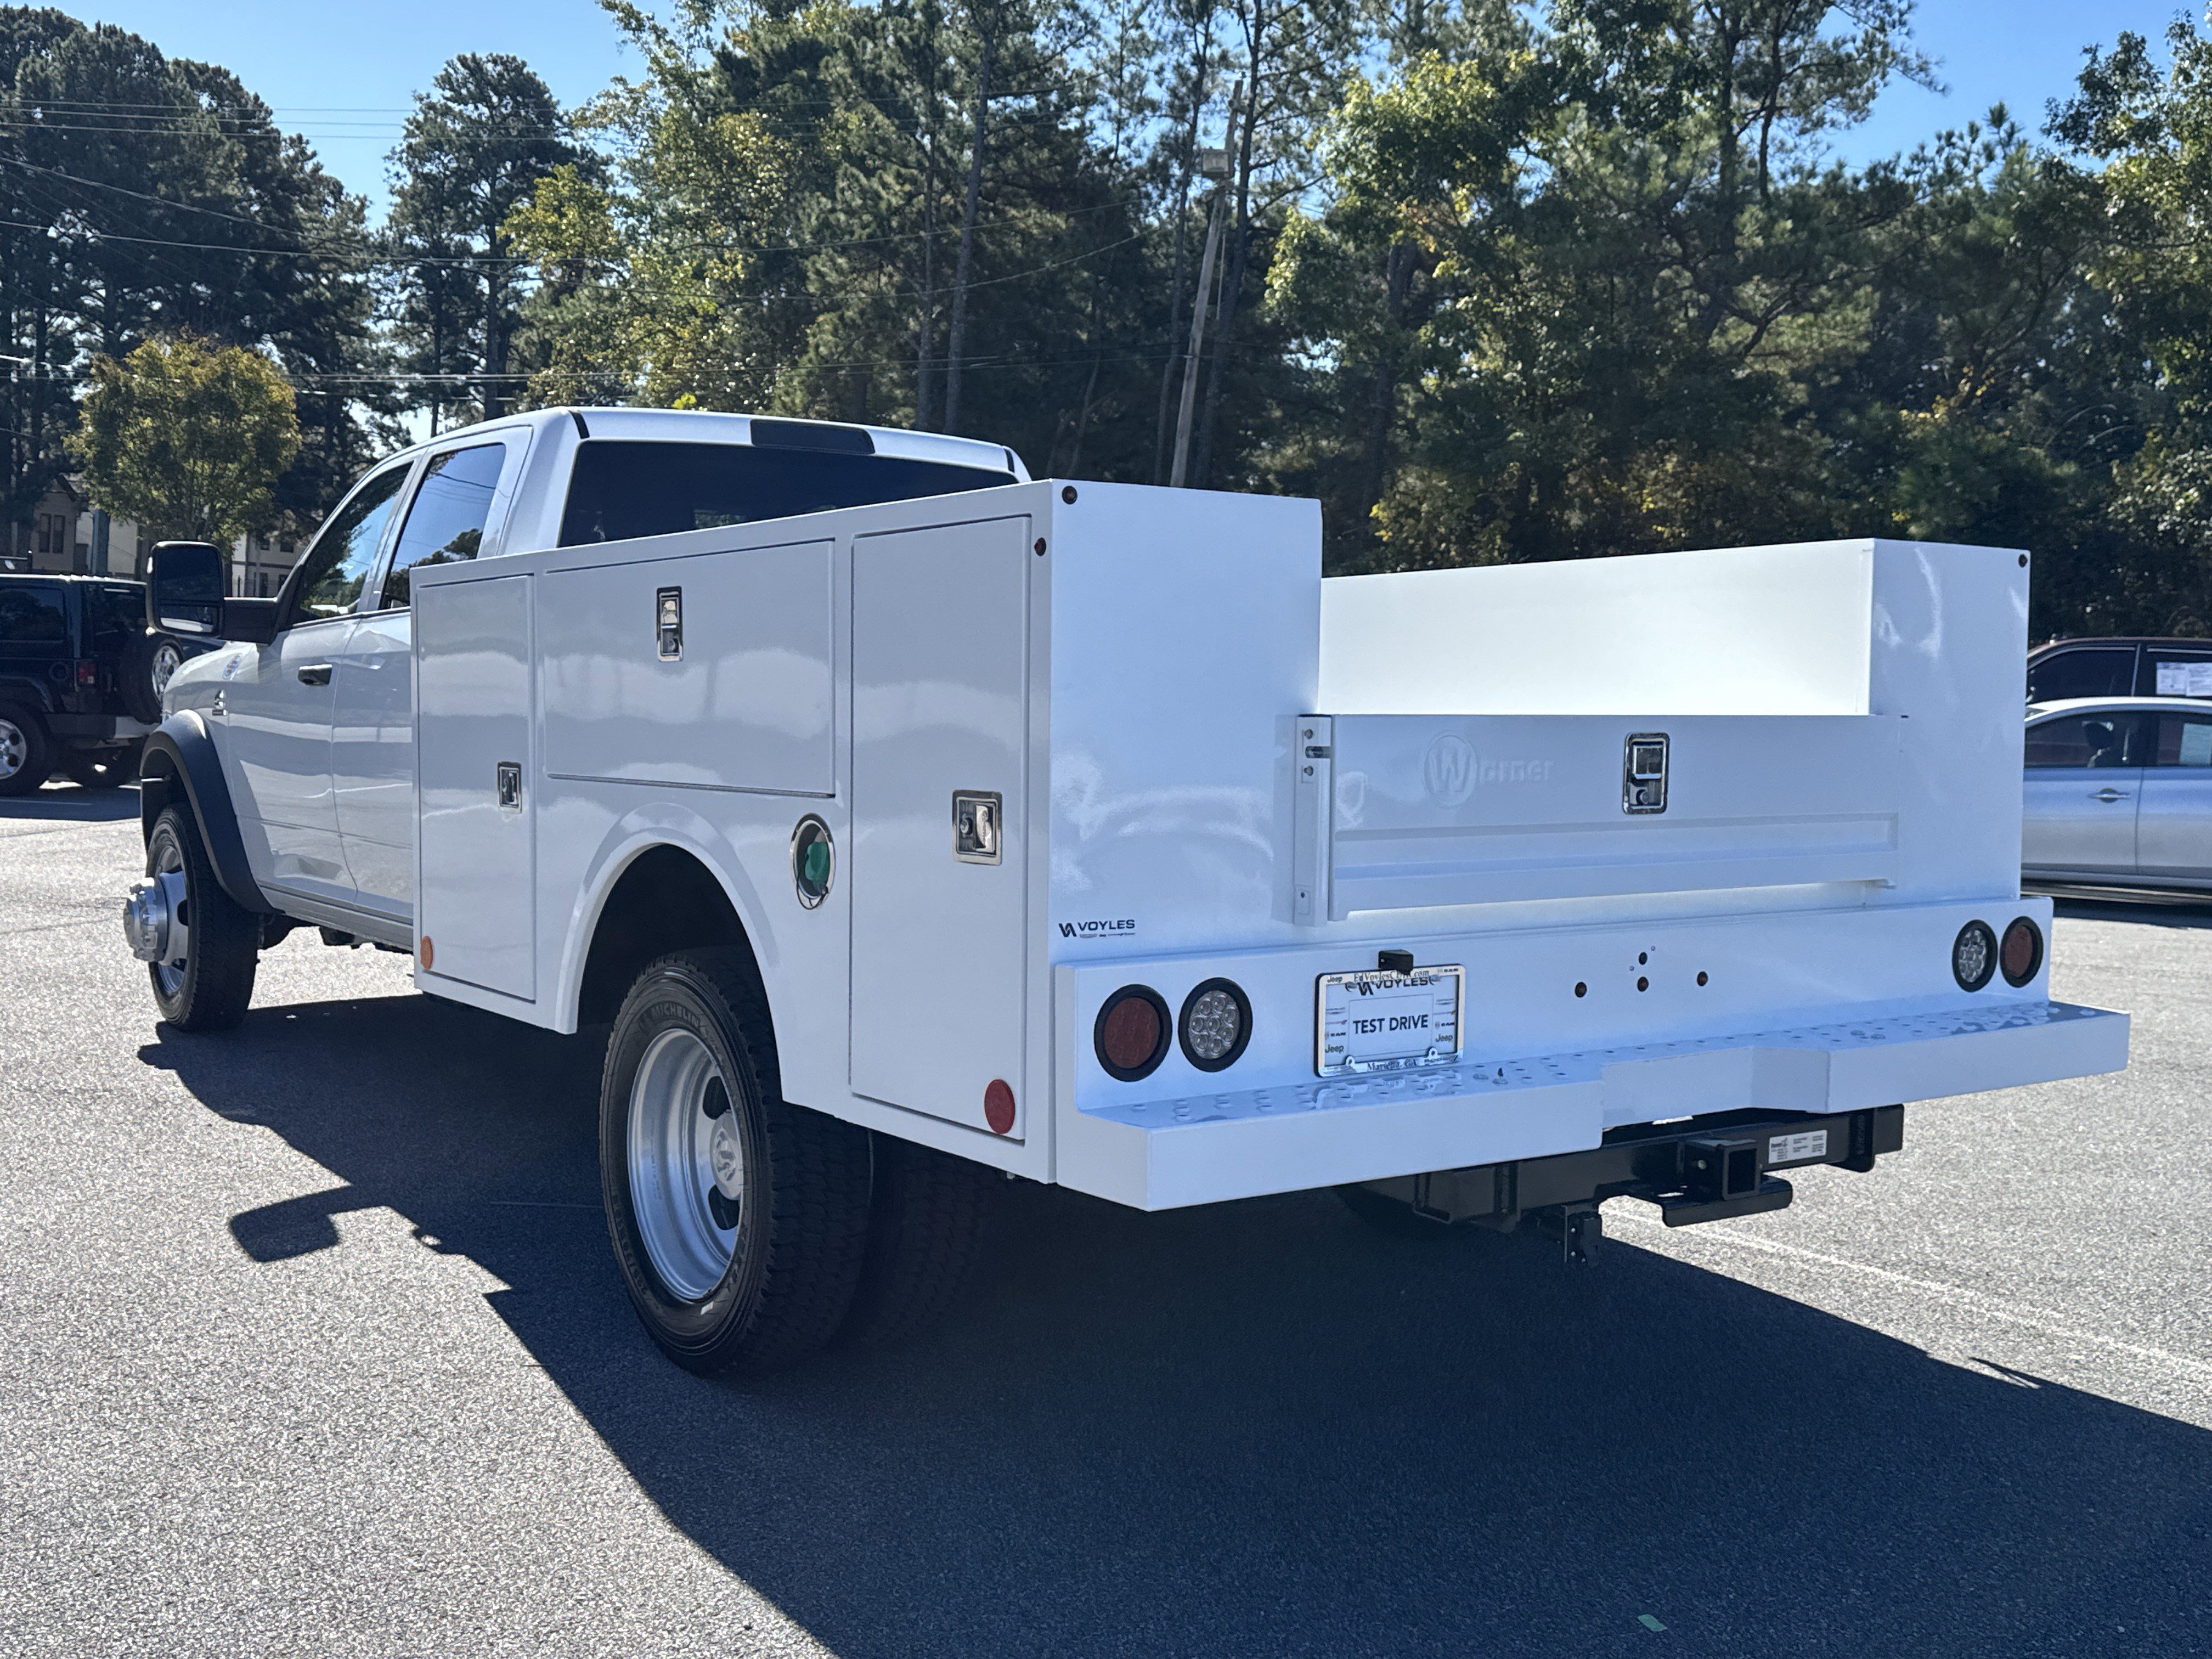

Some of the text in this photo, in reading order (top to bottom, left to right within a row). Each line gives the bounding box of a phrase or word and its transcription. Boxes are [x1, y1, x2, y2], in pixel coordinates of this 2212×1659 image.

[1077, 919, 1135, 931] VOYLES
[651, 1003, 700, 1028] MICHELIN
[1352, 1014, 1429, 1034] TEST DRIVE
[1435, 1034, 1453, 1043] Jeep
[1325, 1045, 1344, 1053] Jeep
